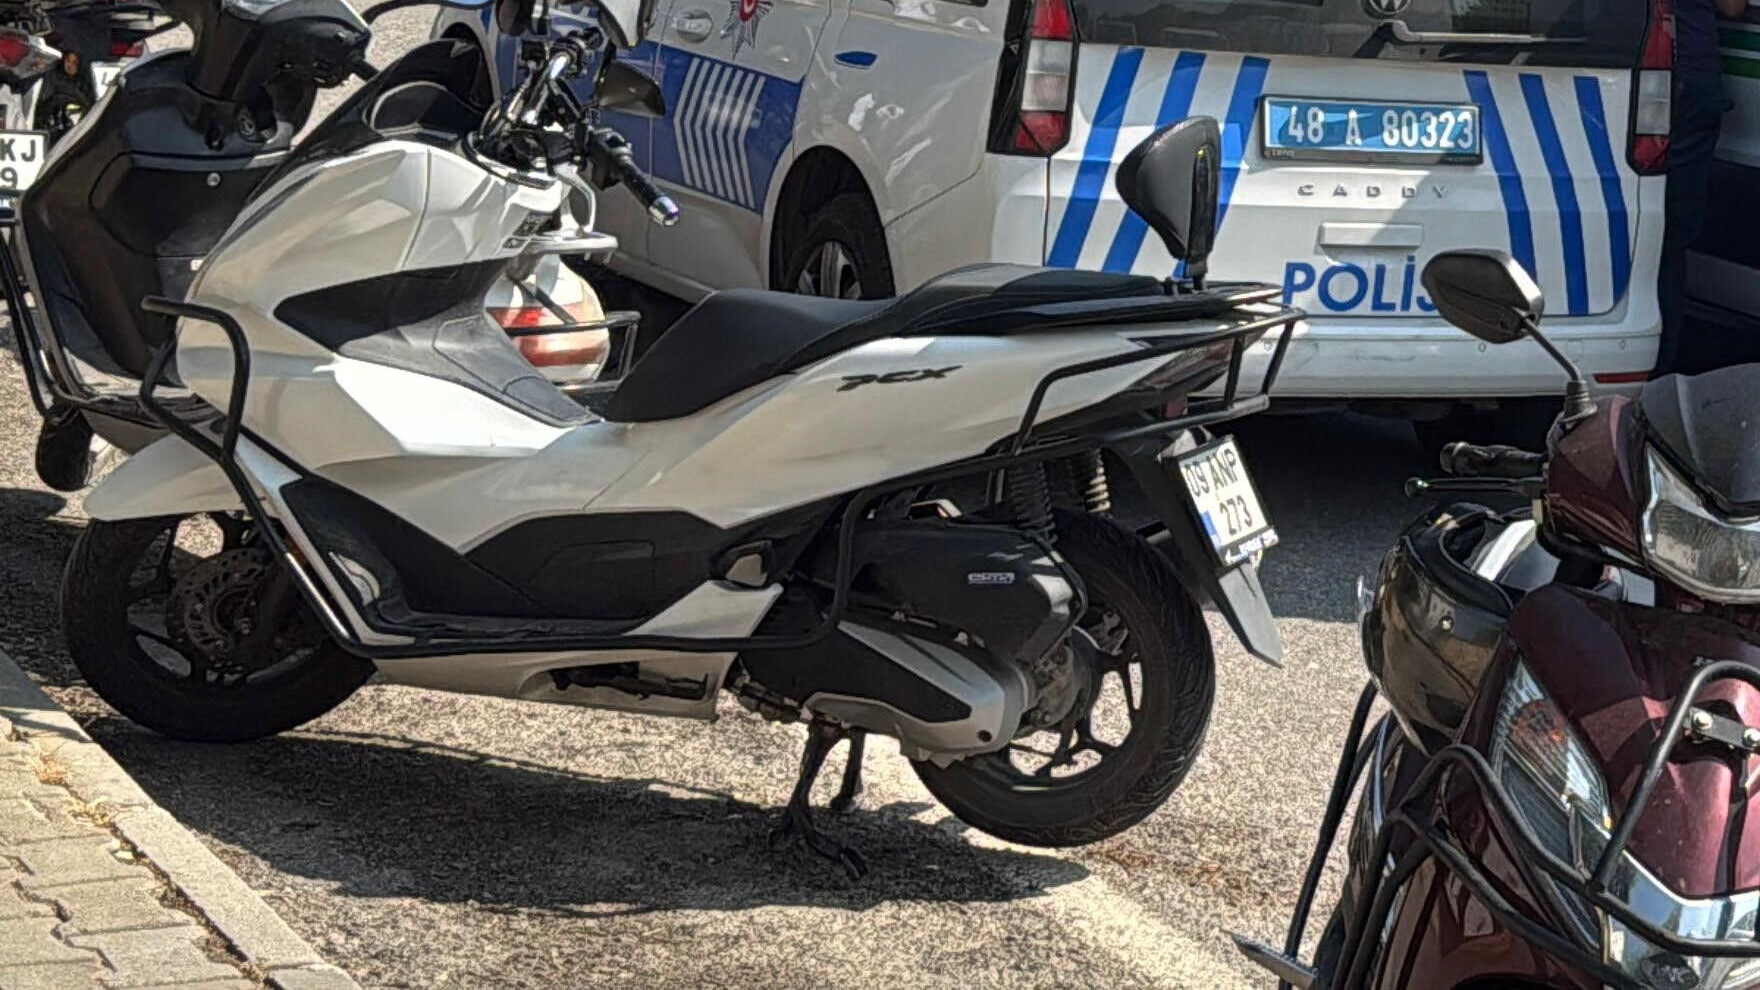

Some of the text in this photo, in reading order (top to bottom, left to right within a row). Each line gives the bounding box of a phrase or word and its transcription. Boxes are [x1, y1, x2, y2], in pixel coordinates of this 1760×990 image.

[1288, 105, 1474, 149] 48 A 80323
[1297, 184, 1448, 199] CADDY
[1184, 448, 1239, 498] 09 ANP
[1219, 494, 1253, 536] 273
